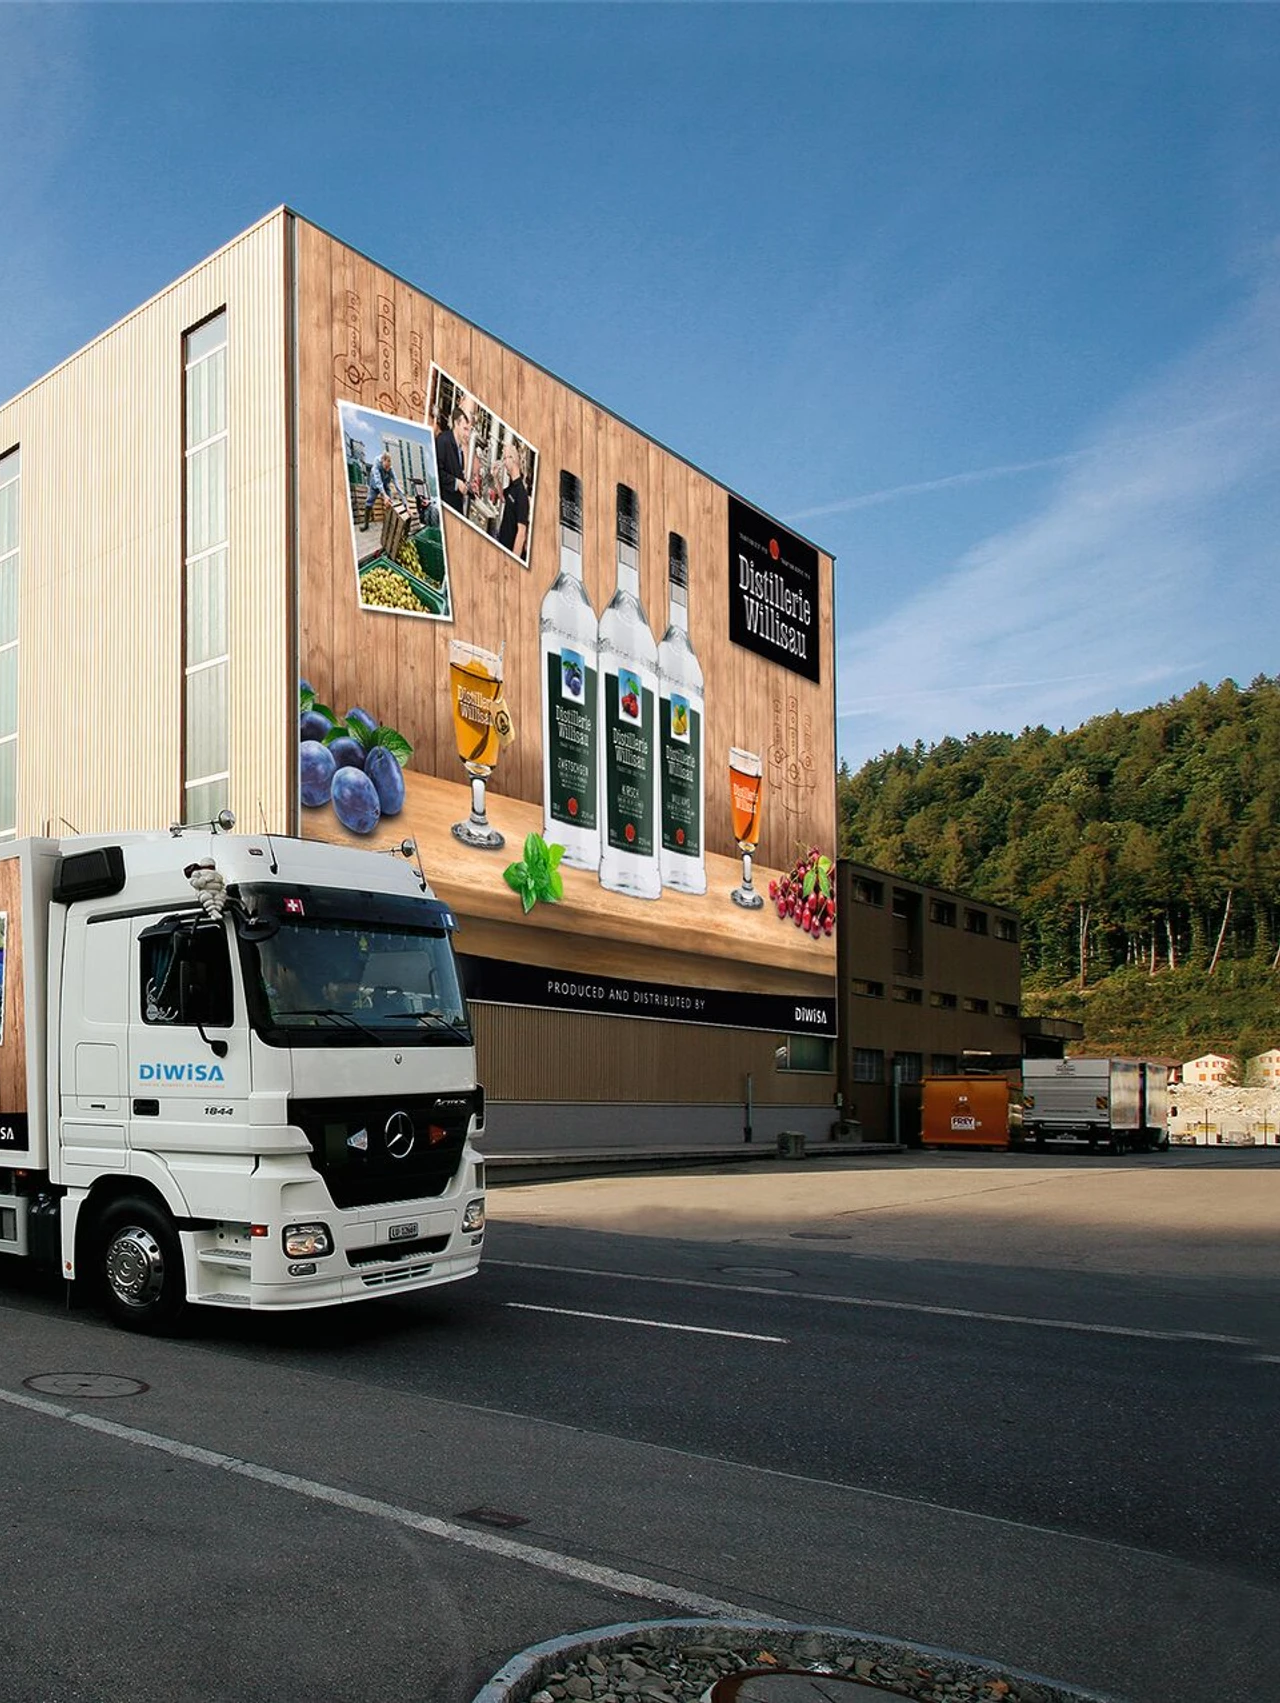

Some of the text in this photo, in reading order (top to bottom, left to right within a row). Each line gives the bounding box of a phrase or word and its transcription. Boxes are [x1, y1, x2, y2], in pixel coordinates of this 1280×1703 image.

[738, 553, 811, 626] Distillerie
[743, 595, 808, 660] Willisau
[548, 981, 705, 1010] PRODUCED AND DISTRIBUTED BY
[204, 1106, 234, 1116] 1844
